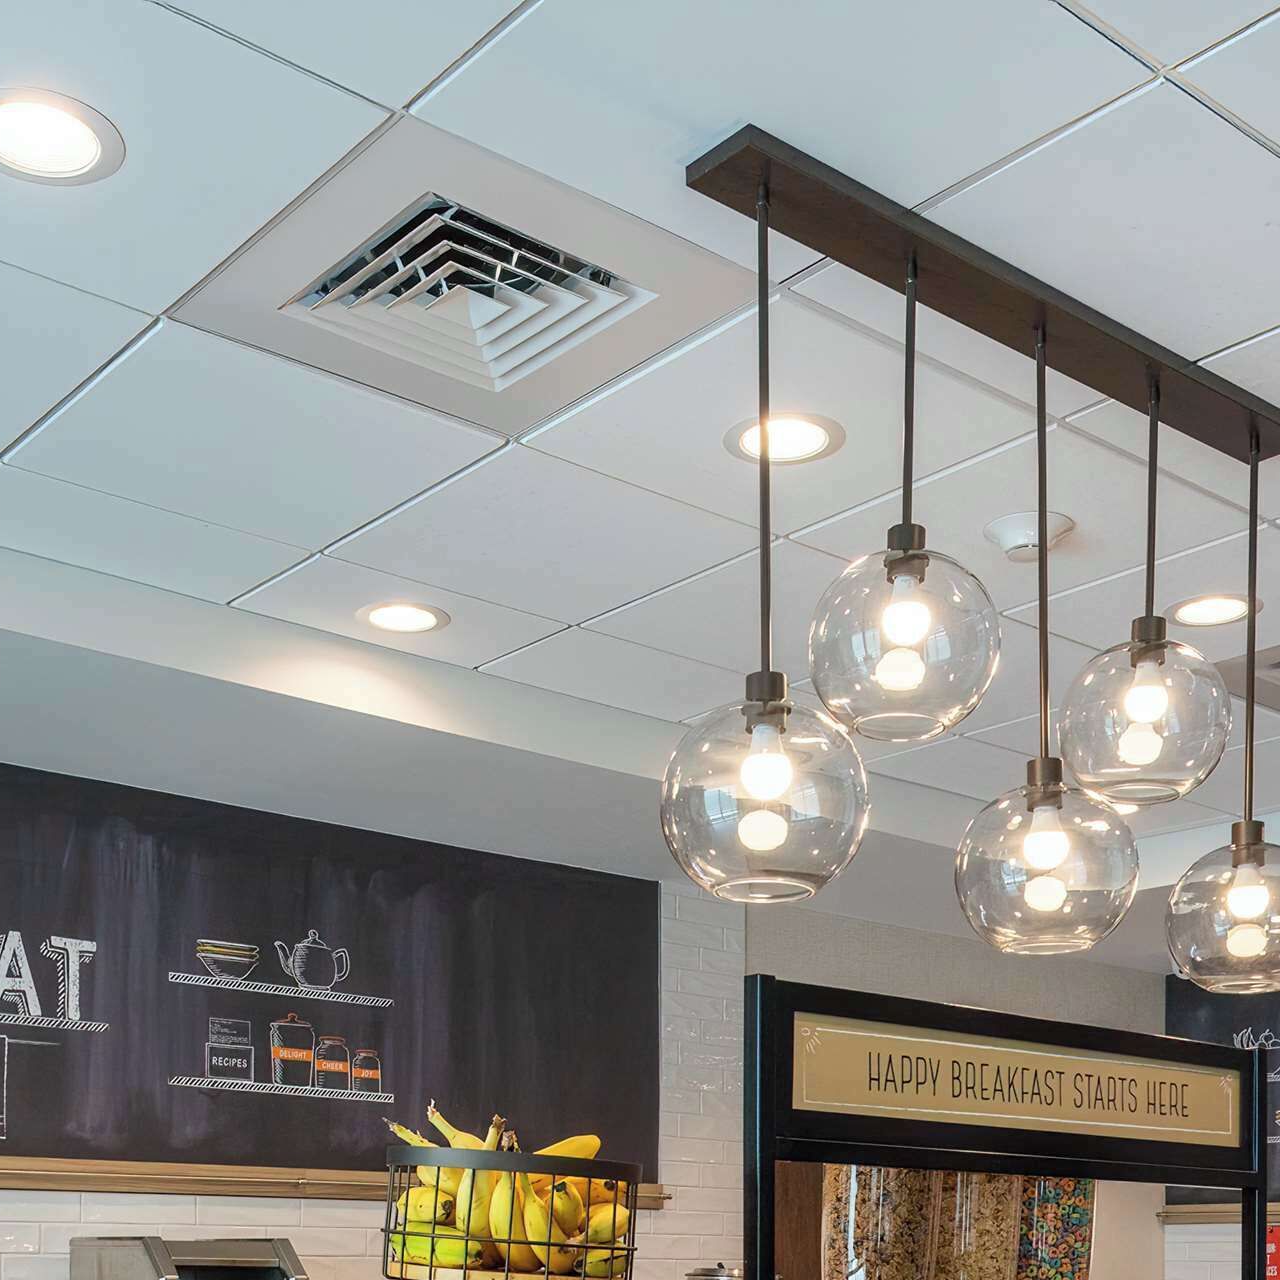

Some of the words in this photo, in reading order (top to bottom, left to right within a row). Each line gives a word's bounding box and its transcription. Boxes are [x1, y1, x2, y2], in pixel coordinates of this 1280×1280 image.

[280, 1048, 307, 1059] DELIGHT
[212, 1056, 248, 1068] RECIPES
[322, 1062, 343, 1071] CHEER
[361, 1070, 373, 1079] JOY
[868, 1051, 941, 1097] HAPPY
[951, 1060, 1065, 1107] BREAKFAST
[1073, 1071, 1138, 1113] STARTS
[1147, 1079, 1189, 1118] HERE
